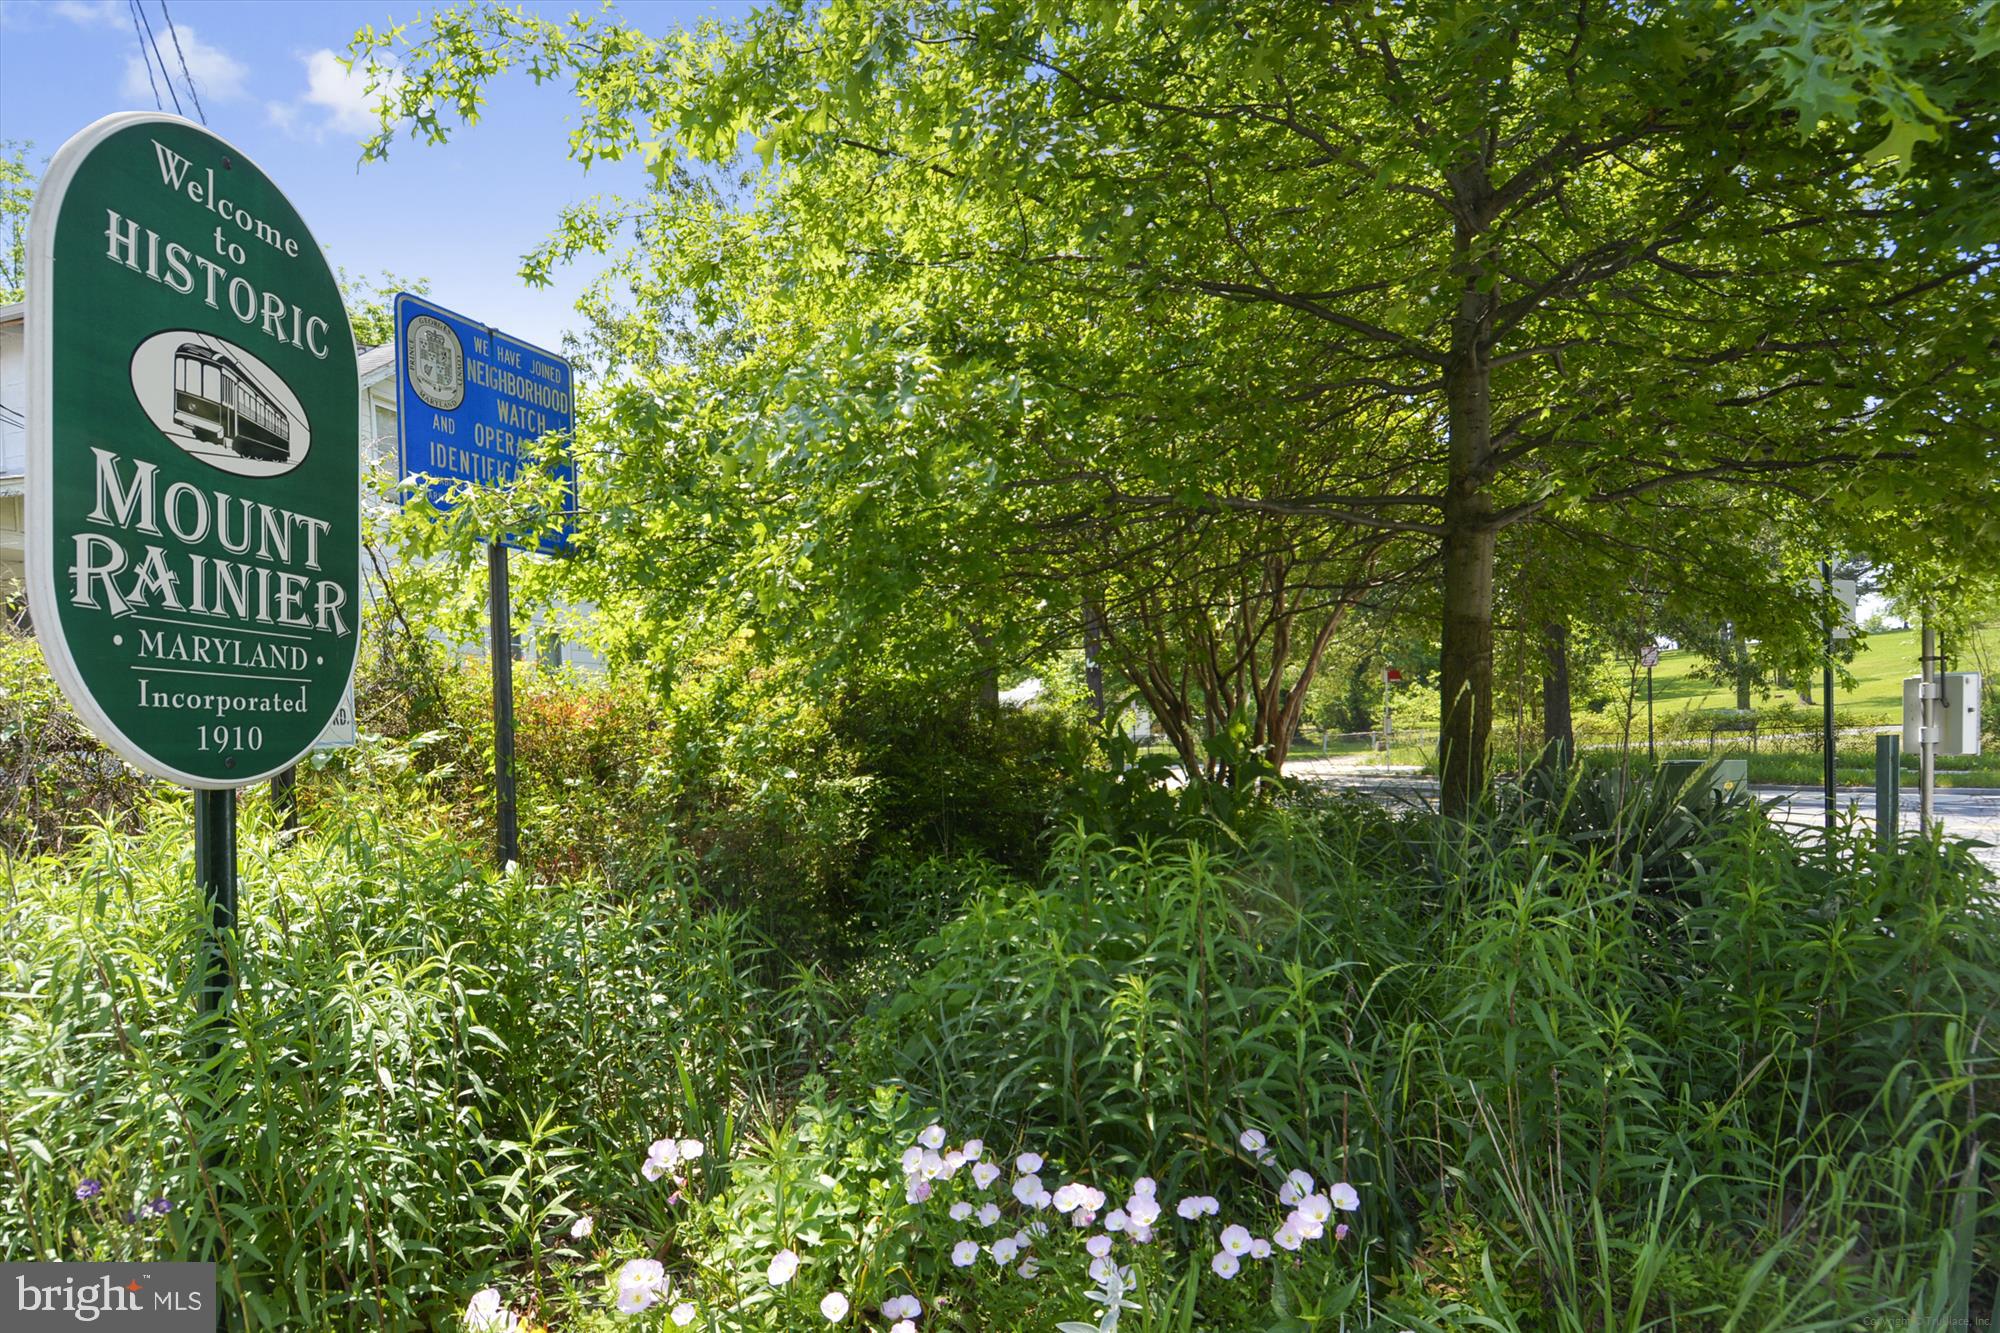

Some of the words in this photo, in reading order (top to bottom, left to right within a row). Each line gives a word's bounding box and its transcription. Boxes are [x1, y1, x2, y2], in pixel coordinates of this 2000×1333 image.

[151, 138, 299, 257] Welcome
[213, 226, 246, 265] to
[105, 208, 329, 359] HISTORIC
[473, 335, 489, 357] WE
[497, 346, 521, 369] HAVE
[529, 359, 561, 384] JOINED
[467, 358, 568, 414] NEIGHBORHOOD
[433, 413, 455, 434] AND
[497, 398, 546, 434] WATCH
[474, 423, 526, 457] OPERA
[86, 447, 332, 571] MOUNT
[68, 533, 351, 638] RAINIER
[137, 629, 308, 671] MARYLAND
[137, 679, 308, 717] Incorporated
[197, 725, 263, 754] 1910
